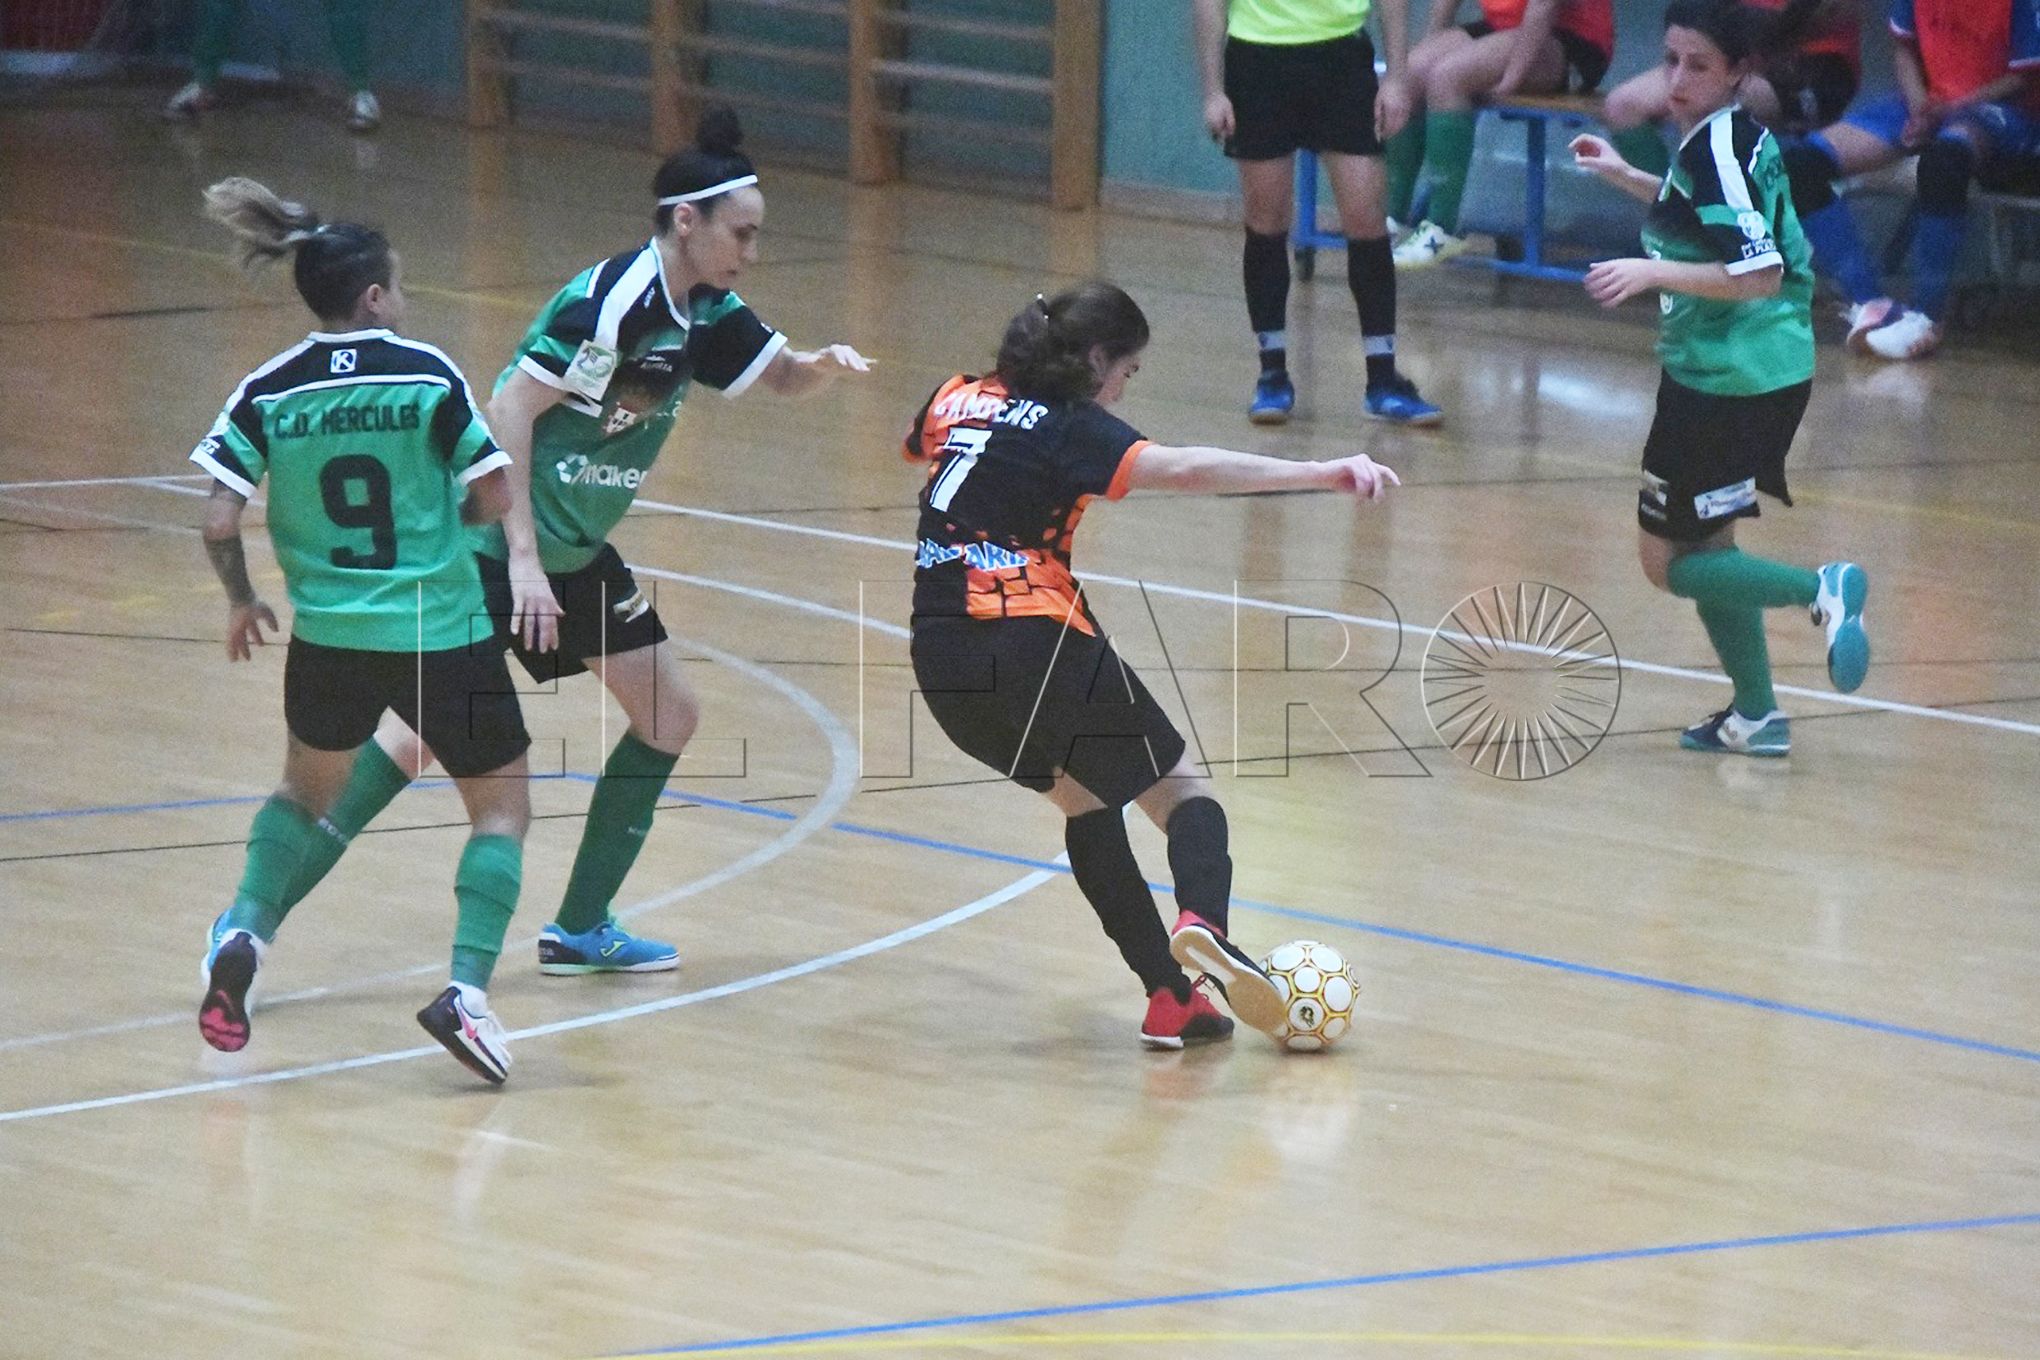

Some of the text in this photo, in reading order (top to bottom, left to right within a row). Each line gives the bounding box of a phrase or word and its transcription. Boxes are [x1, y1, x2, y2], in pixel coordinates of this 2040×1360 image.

[321, 401, 421, 436] HERCULES
[319, 453, 397, 570] 9
[929, 426, 993, 513] 7
